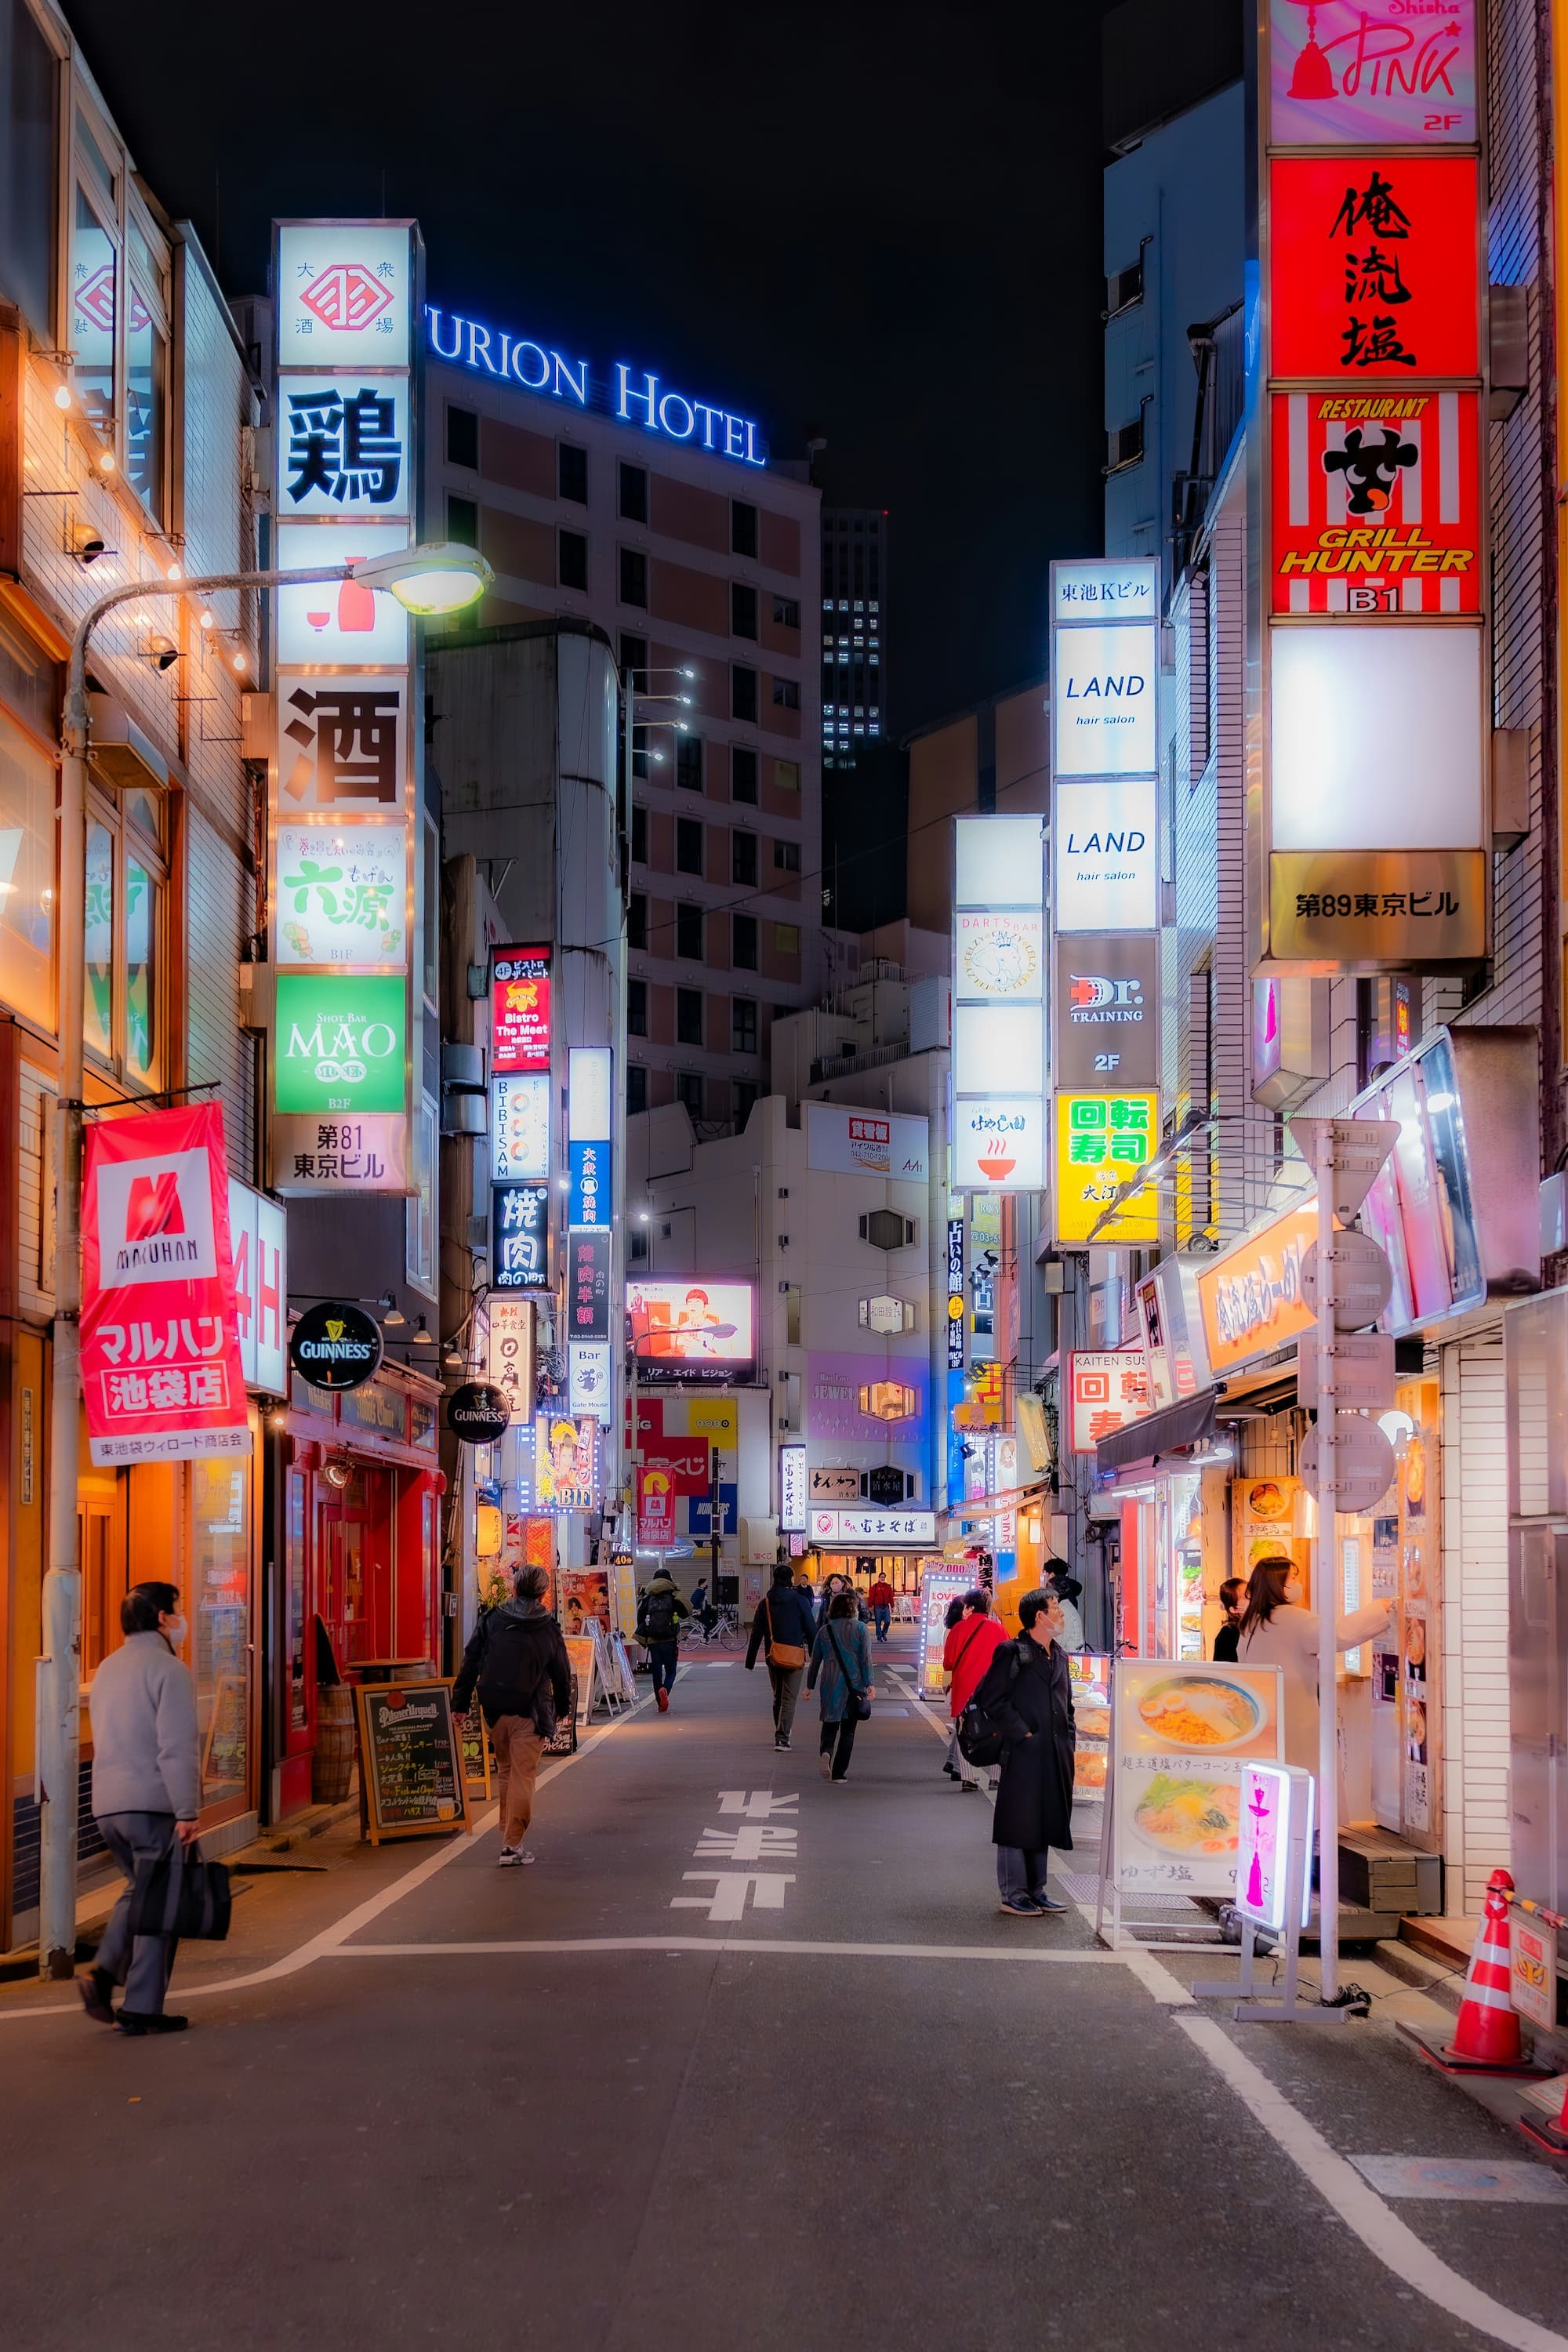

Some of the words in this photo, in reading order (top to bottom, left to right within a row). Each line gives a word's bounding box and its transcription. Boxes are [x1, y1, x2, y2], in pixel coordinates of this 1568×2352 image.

[1388, 0, 1461, 14] Shisha
[1424, 114, 1462, 130] 2F
[297, 262, 314, 278] 大
[1329, 171, 1417, 367] 俺流塩
[296, 318, 313, 334] 酒
[424, 303, 589, 405] URION
[1317, 397, 1429, 419] RESTAURANT
[287, 388, 401, 503] 鶏
[1318, 526, 1433, 548] GRILL
[1278, 549, 1475, 574] HUNTER
[1061, 582, 1150, 602] 東池Kビル
[1348, 587, 1399, 612] B1
[1066, 676, 1145, 698] LAND
[1076, 715, 1100, 725] hair
[1104, 715, 1135, 724] salon
[284, 687, 400, 803] 酒
[1067, 832, 1145, 854] LAND
[1076, 871, 1101, 881] hair
[1103, 871, 1136, 880] salon
[283, 860, 394, 931] 六源
[1296, 892, 1459, 918] 第89東京ビル
[961, 918, 1011, 929] DARTS
[330, 949, 353, 960] B1F
[514, 960, 544, 970] ビストロ
[512, 969, 549, 980] ザ・ミート
[1069, 973, 1144, 1011] Dr.
[505, 1013, 539, 1024] Bistro
[1070, 1011, 1144, 1023] TRAINING
[284, 1023, 397, 1058] MAO
[495, 1025, 517, 1036] The
[520, 1024, 548, 1036] Meat
[1094, 1054, 1120, 1071] 2F
[328, 1098, 351, 1109] B2F
[1069, 1099, 1150, 1132] 回転
[317, 1124, 363, 1152] 第81
[498, 1082, 508, 1176] BIBISAM
[1069, 1133, 1150, 1165] 寿司
[293, 1152, 384, 1180] 東京ビル
[583, 1148, 596, 1175] 大衆
[1080, 1185, 1119, 1200] 大江
[583, 1196, 596, 1223] 焼肉
[503, 1189, 539, 1271] 焼肉
[949, 1221, 963, 1293] 占いの館
[498, 1271, 546, 1286] 肉の町
[577, 1244, 594, 1324] 焼肉半額
[234, 1230, 281, 1352] 4H
[492, 1319, 526, 1331] 中華食堂
[97, 1316, 223, 1365] マルハン
[299, 1340, 371, 1364] GUINNESS
[579, 1351, 601, 1360] Bar
[1075, 1356, 1120, 1366] KAITEN
[702, 1369, 732, 1377] ビジョン
[109, 1366, 223, 1412] 池袋店
[812, 1385, 856, 1400] JEWEL
[455, 1409, 503, 1423] GUINNESS
[100, 1432, 242, 1457] 東池袋ウィロード商店会
[538, 1450, 555, 1500] 大奥
[813, 1472, 856, 1489] とんかつ
[697, 1502, 730, 1515] NUMERS
[640, 1518, 671, 1528] マルハン
[1121, 1864, 1195, 1882] ゆず塩
